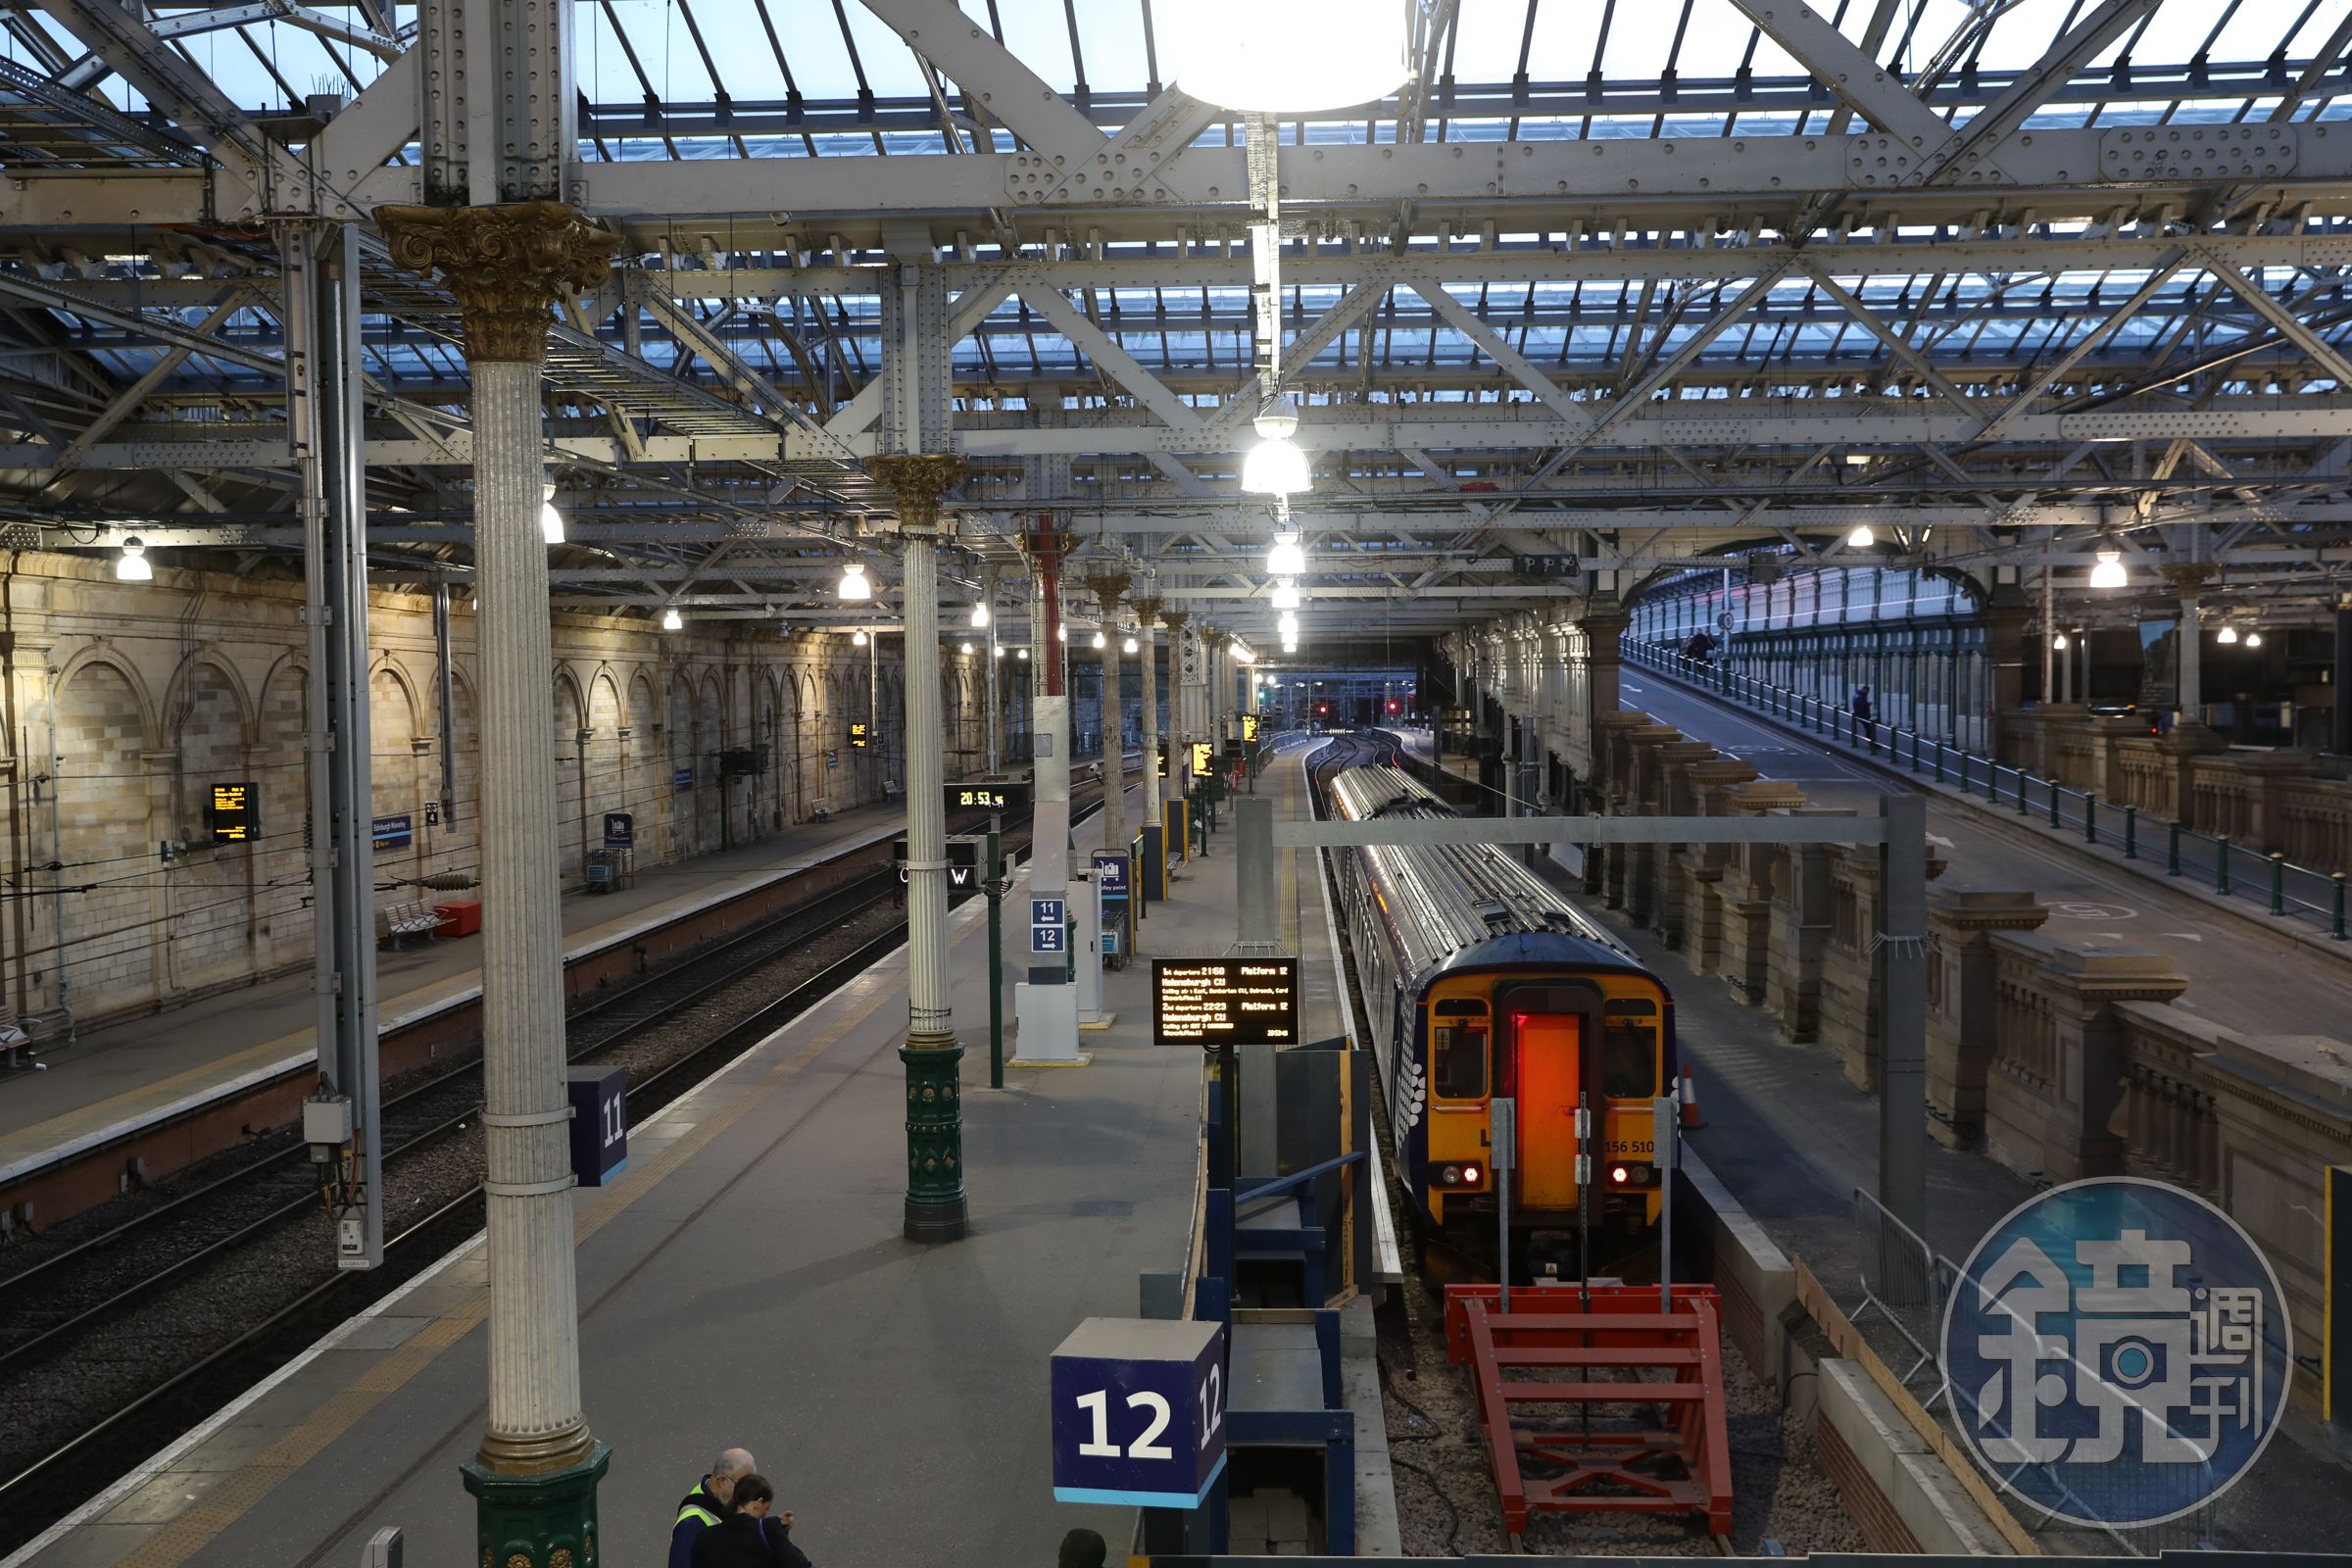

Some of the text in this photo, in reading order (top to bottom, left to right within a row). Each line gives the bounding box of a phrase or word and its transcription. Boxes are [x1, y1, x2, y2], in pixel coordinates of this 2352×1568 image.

[960, 792, 991, 806] 20:53
[951, 868, 968, 884] W
[1040, 902, 1054, 913] 11
[1040, 929, 1055, 942] 12
[1241, 966, 1288, 975] Platform 12
[1162, 978, 1211, 987] Helensburgh
[1162, 1013, 1212, 1022] Helensburgh
[604, 1091, 623, 1148] 11
[1604, 1141, 1654, 1152] 156 510
[1199, 1363, 1221, 1451] 12
[1076, 1389, 1173, 1459] 12
